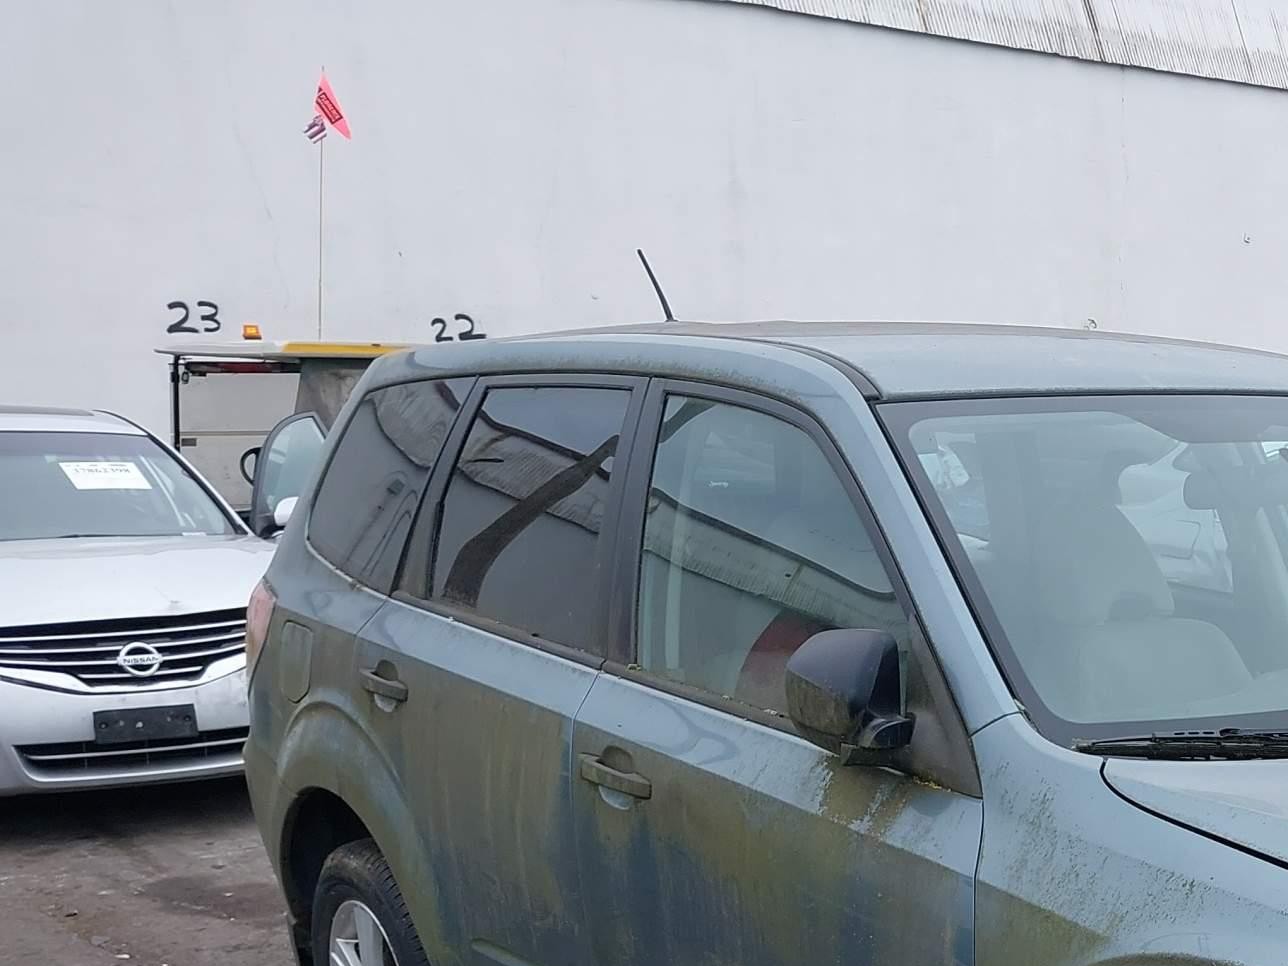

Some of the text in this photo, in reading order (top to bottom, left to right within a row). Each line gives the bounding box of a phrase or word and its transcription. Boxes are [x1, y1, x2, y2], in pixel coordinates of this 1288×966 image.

[167, 301, 221, 333] 23
[430, 314, 486, 342] 22
[122, 656, 160, 665] NISSAN
